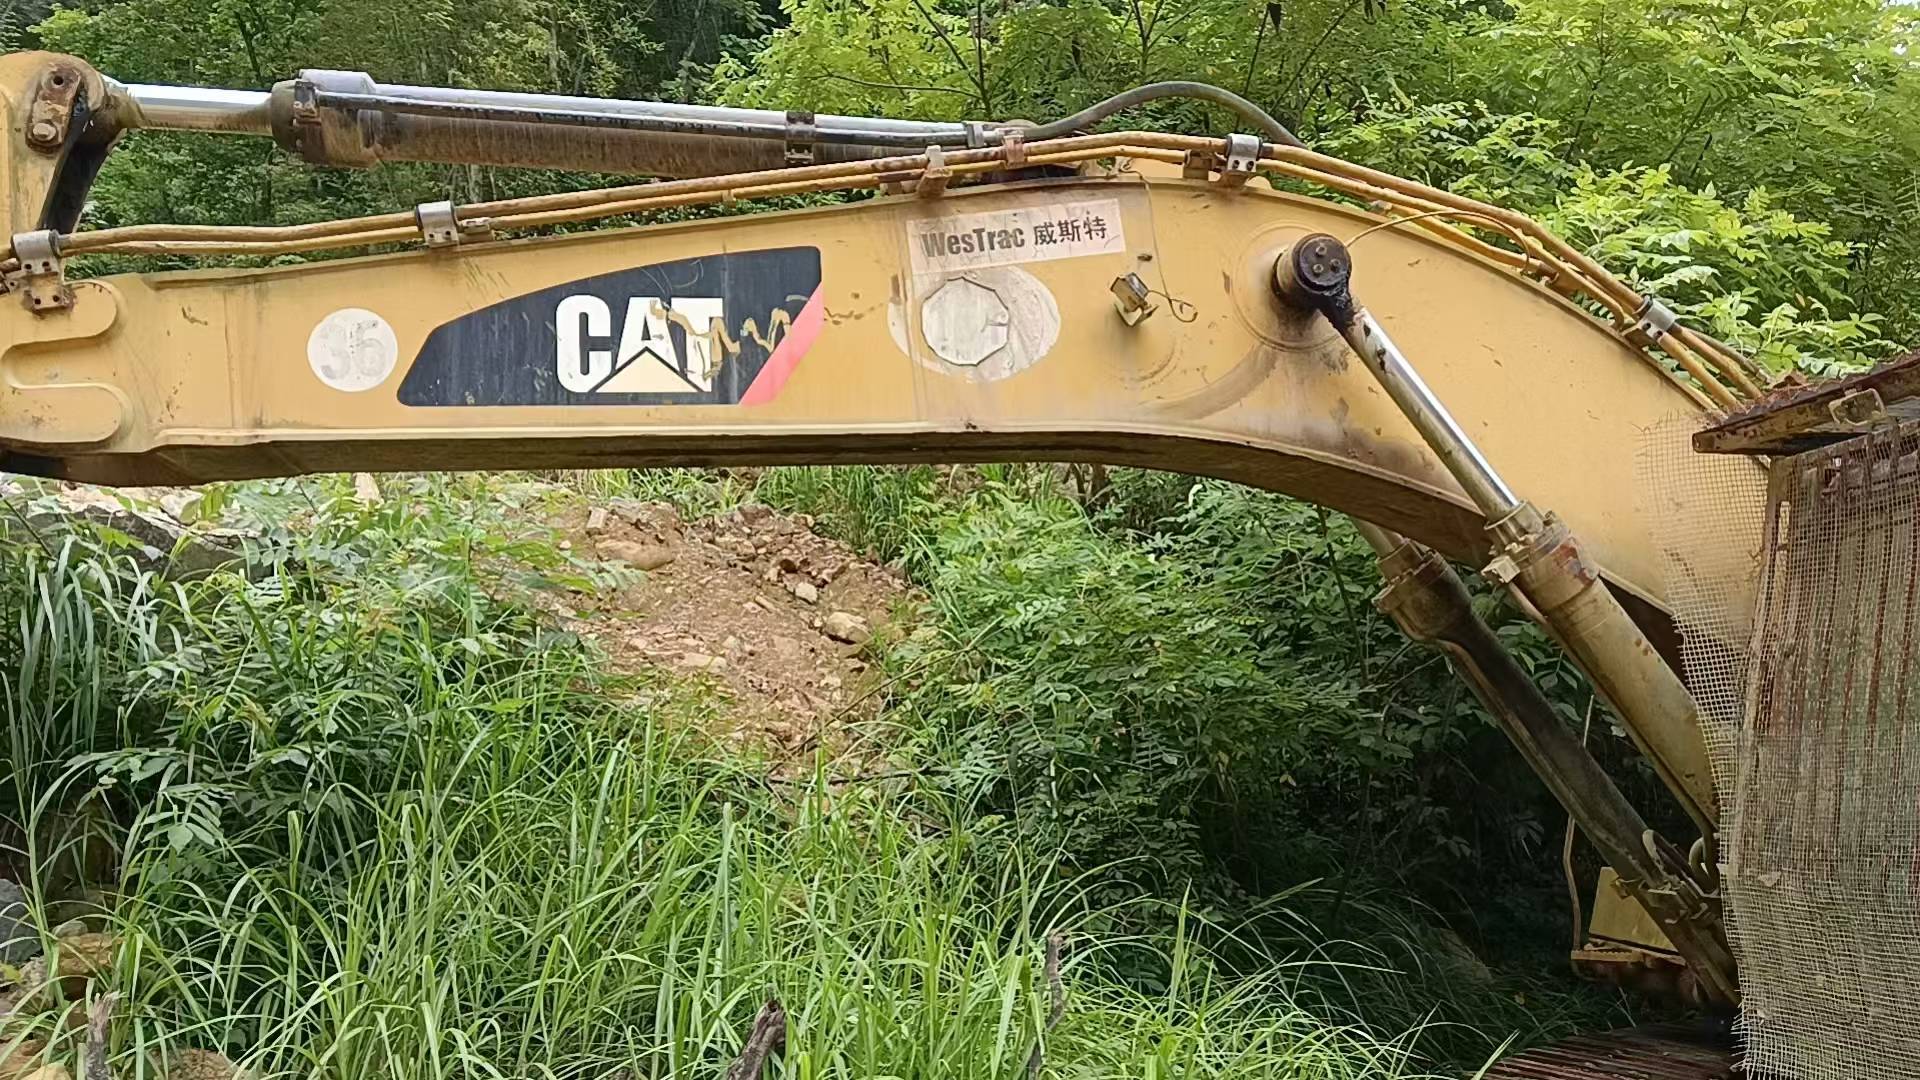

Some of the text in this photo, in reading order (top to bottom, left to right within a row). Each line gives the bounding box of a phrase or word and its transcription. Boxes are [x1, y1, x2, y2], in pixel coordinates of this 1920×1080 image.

[922, 215, 1107, 257] WesTrac 威斯特
[556, 295, 723, 393] CAT
